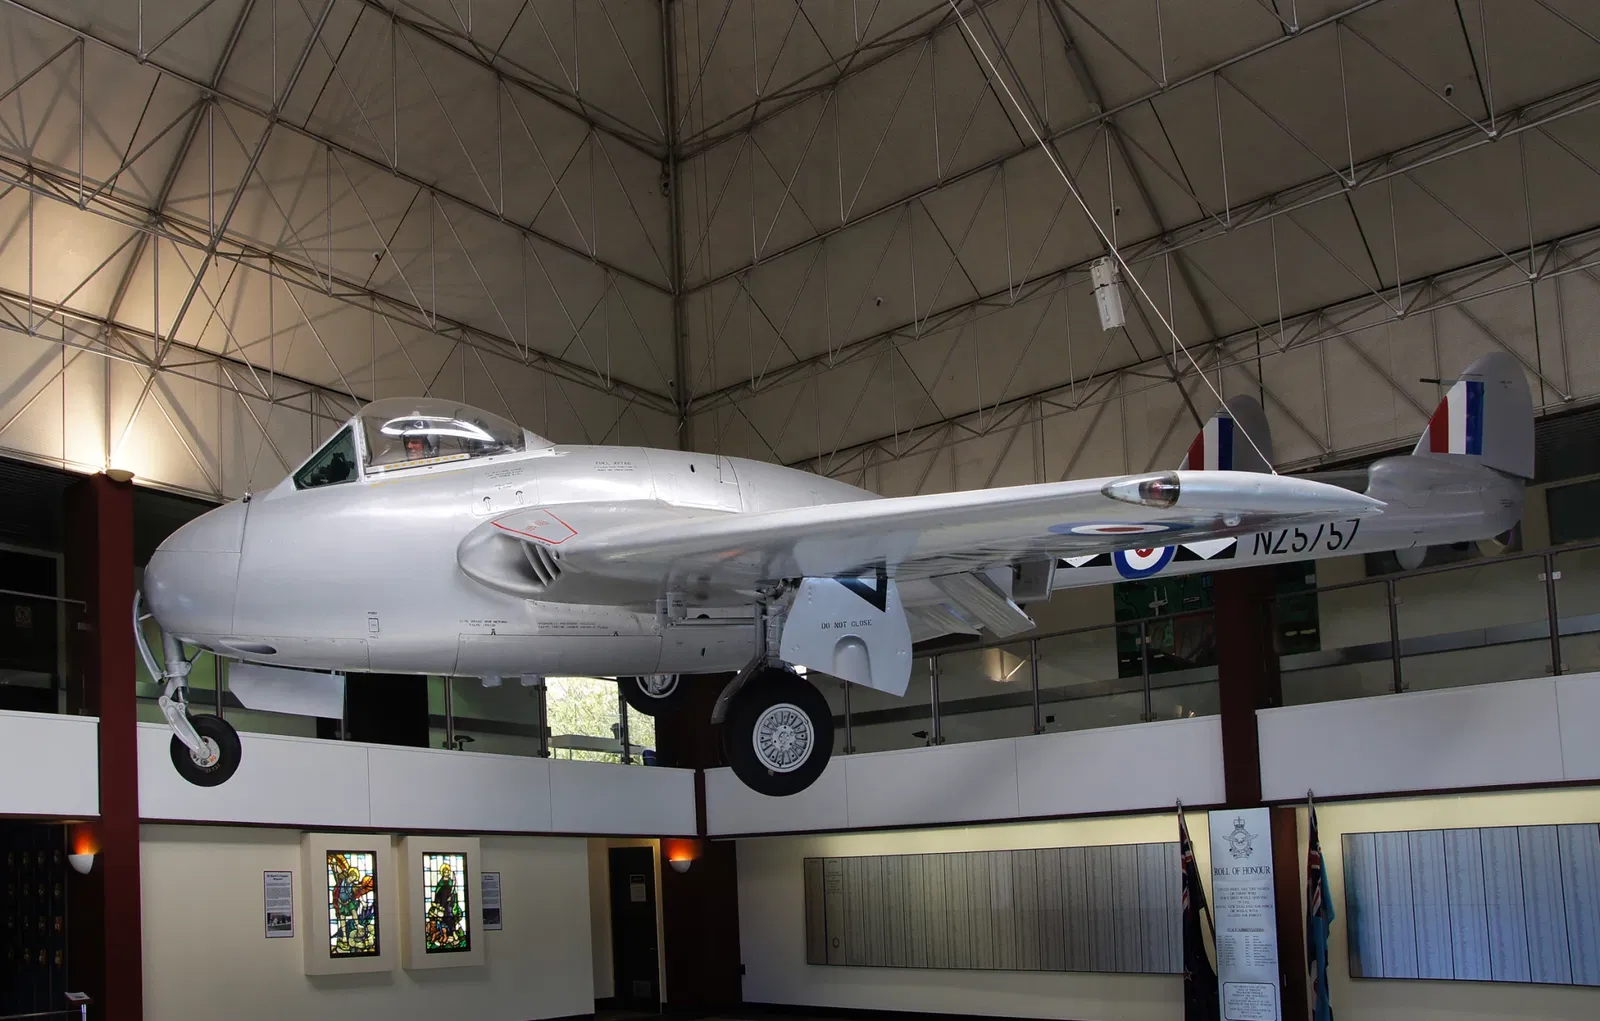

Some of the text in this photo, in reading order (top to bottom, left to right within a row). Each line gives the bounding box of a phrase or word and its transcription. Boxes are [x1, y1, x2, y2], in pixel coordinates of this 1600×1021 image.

[821, 619, 873, 630] DO NOT CLOSE
[1214, 865, 1271, 876] ROLL OF HONOUR
